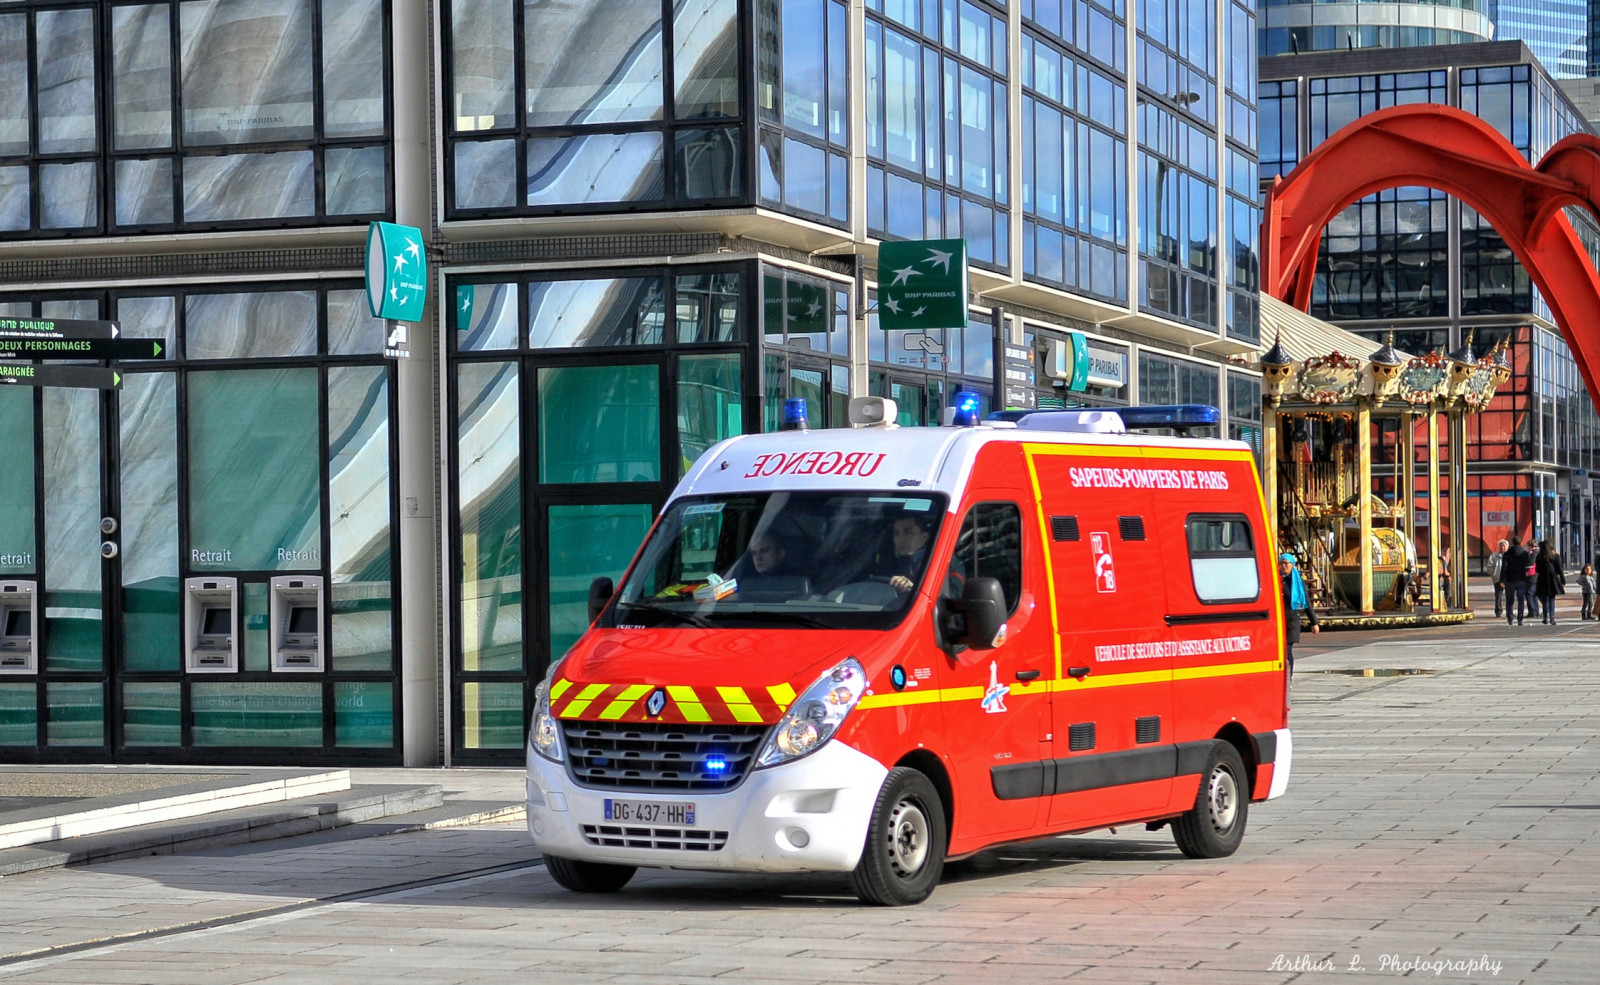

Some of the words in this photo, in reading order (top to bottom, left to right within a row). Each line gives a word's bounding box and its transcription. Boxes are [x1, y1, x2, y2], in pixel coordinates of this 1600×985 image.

[0, 341, 22, 351] DEUX
[25, 341, 91, 351] PERSONNAGES
[1095, 358, 1119, 376] PARIBAS
[1069, 467, 1181, 489] SAPEURS-POMPIERS
[1180, 470, 1198, 489] DE
[1197, 471, 1229, 490] PARIS
[1091, 535, 1104, 554] 112
[0, 552, 32, 565] etrait
[192, 548, 232, 562] Retrait
[278, 548, 319, 561] Retrait
[1104, 570, 1115, 590] 18
[1094, 645, 1127, 662] VEHICULE
[1126, 643, 1136, 660] DE
[1136, 642, 1164, 659] SECOURS
[1212, 638, 1225, 654] AUX
[1225, 636, 1251, 652] VICTIMES
[613, 803, 684, 823] DG-437-HH
[686, 813, 694, 824] 75
